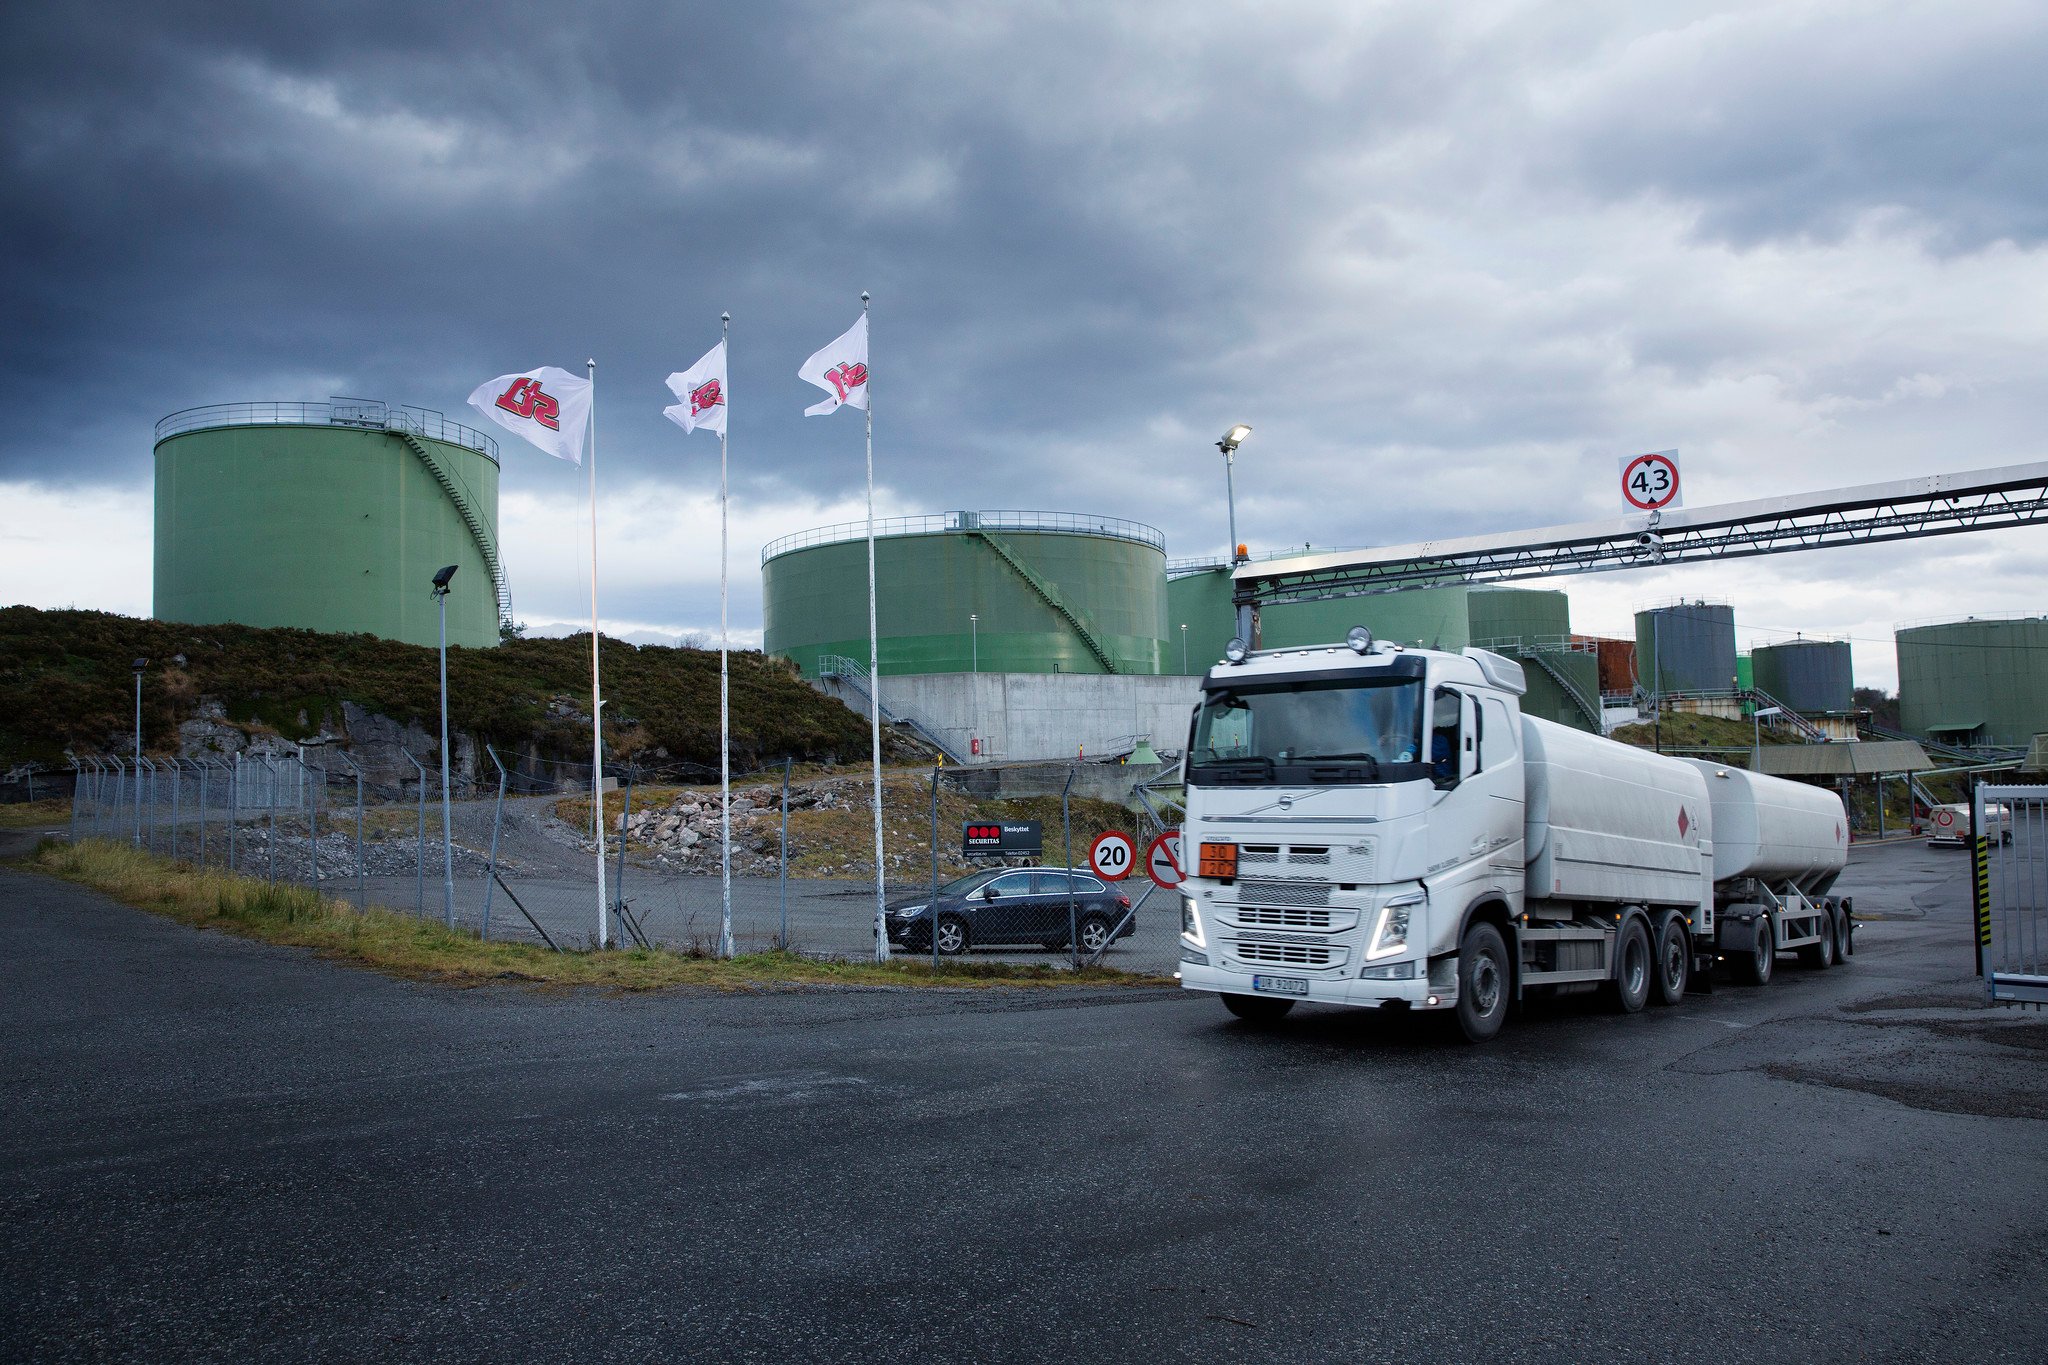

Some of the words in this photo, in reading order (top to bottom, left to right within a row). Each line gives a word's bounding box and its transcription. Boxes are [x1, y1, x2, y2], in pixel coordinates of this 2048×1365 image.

[1631, 468, 1670, 494] 4,3
[1004, 826, 1030, 834] Beskyttet
[1099, 846, 1126, 867] 20
[1210, 845, 1227, 858] 30
[1201, 861, 1236, 876] 1202
